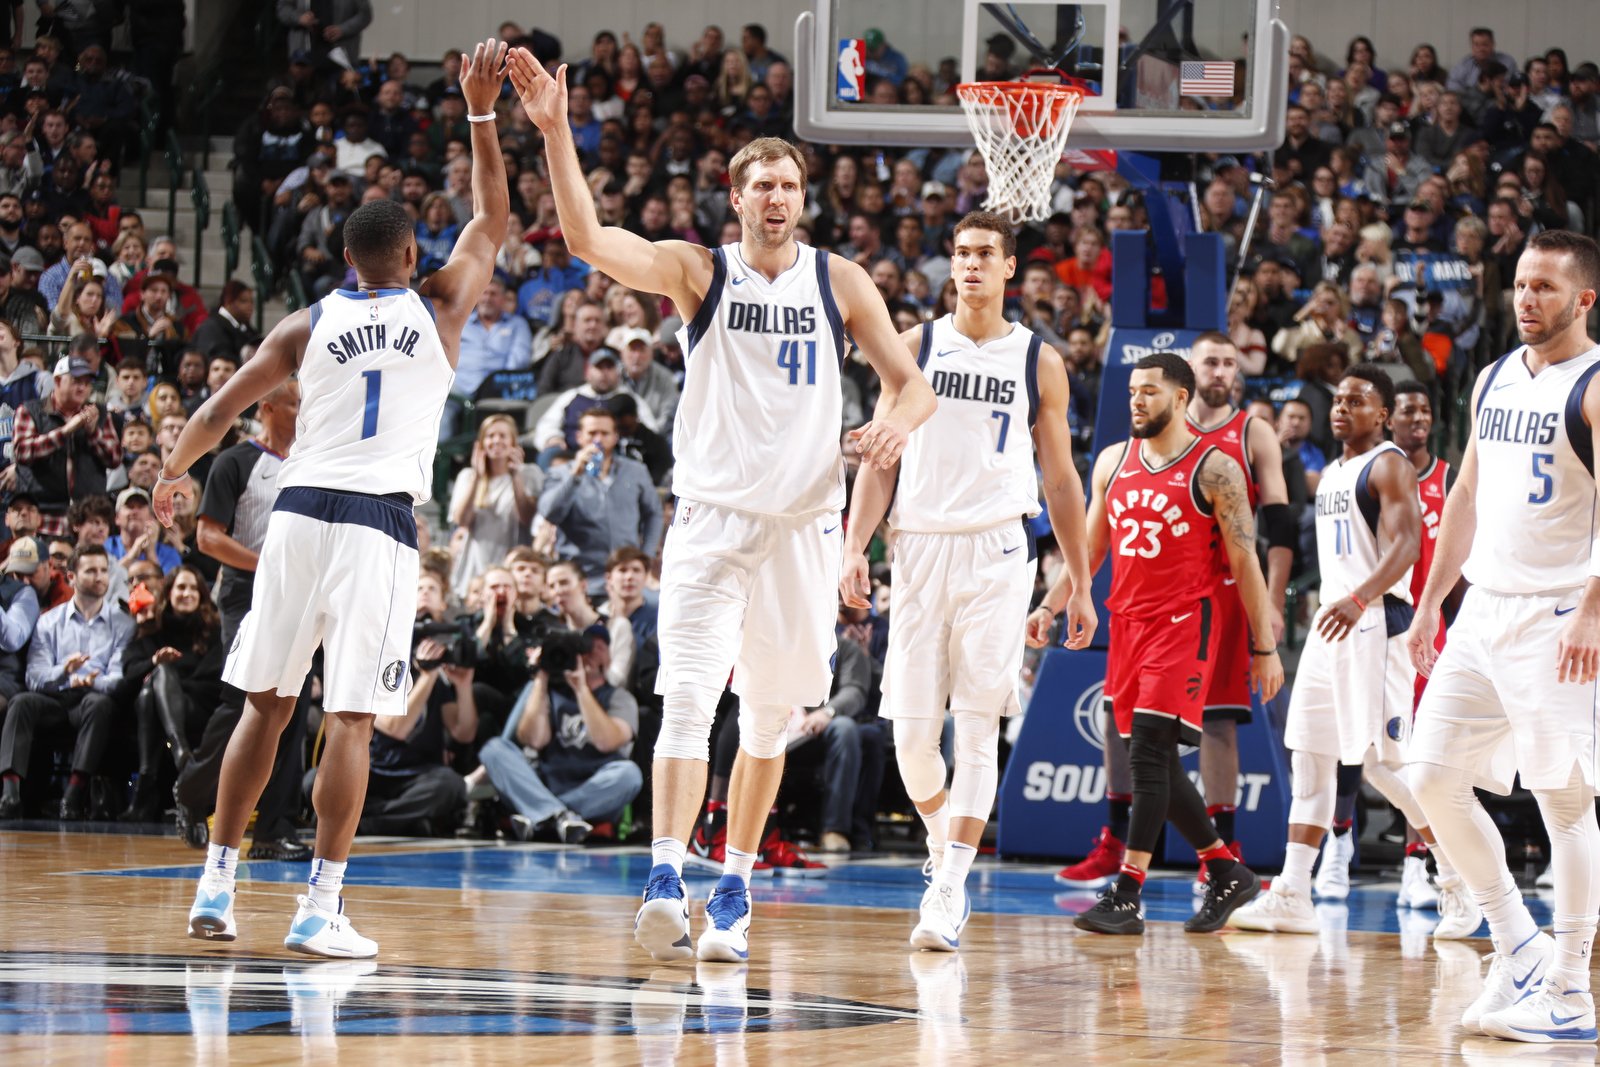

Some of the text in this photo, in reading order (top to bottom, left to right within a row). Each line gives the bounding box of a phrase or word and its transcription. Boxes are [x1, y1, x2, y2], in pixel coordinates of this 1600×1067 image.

[727, 301, 817, 334] DALLAS
[326, 324, 420, 365] SMITH JR.
[777, 340, 817, 386] 41
[360, 370, 383, 441] 1
[931, 370, 1017, 405] DALLAS
[991, 410, 1012, 454] 7
[1479, 406, 1560, 446] DALLAS
[1527, 452, 1555, 505] 5
[1316, 489, 1350, 517] ALLAS
[1118, 517, 1164, 559] 23
[1333, 519, 1353, 556] 11
